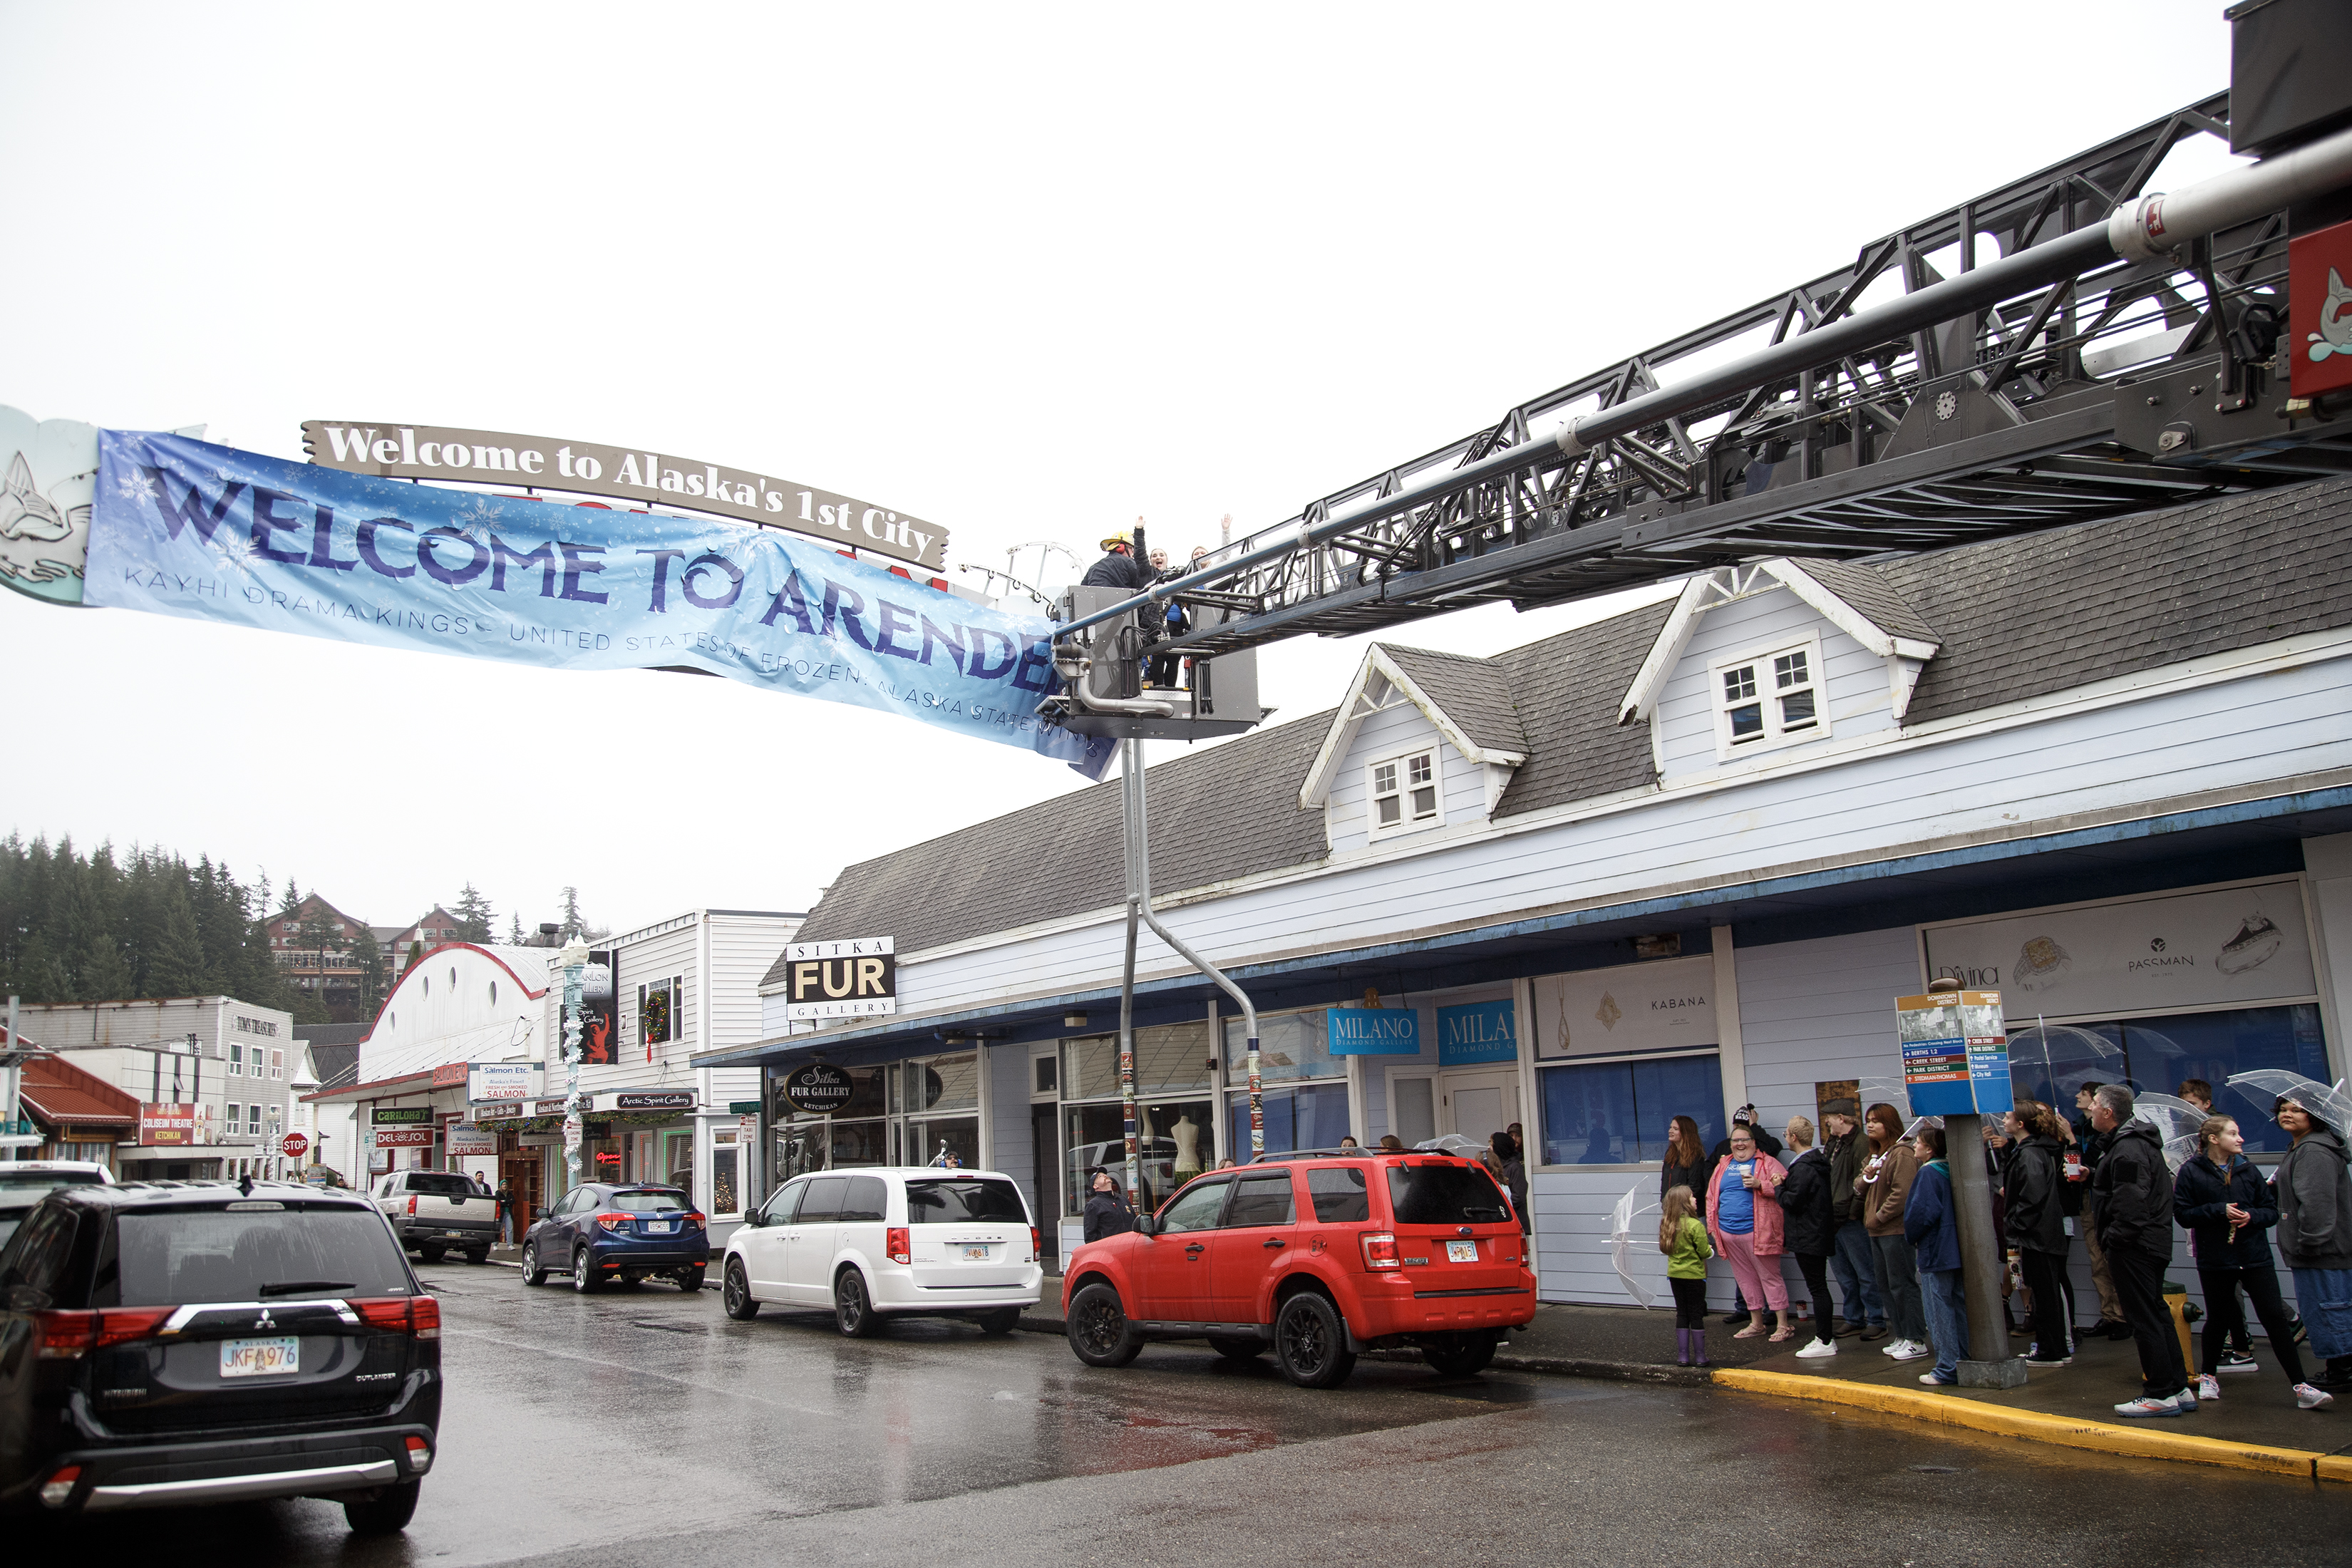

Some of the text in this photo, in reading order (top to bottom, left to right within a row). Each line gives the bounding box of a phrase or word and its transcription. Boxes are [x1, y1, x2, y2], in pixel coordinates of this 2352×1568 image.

[324, 428, 545, 474] Welcome
[556, 446, 602, 480] to
[614, 453, 783, 512] Alaska's
[797, 490, 852, 531] 1st
[862, 508, 935, 562] City
[136, 463, 609, 604] WELCOME
[636, 549, 745, 614] TO
[125, 567, 227, 598] KAYHI
[249, 587, 359, 621] DRAMA
[377, 609, 468, 634] KINGS
[510, 624, 610, 651] UNITED
[626, 631, 719, 652] STATES
[725, 642, 751, 661] OF
[878, 681, 962, 716] ALASKA
[972, 705, 1029, 731] STATE
[798, 941, 883, 957] SITKA
[2128, 955, 2194, 972] PASSMAN
[795, 958, 886, 999] FUR
[1651, 996, 1706, 1010] KABANA
[1927, 993, 1957, 1001] DOWNTOWN
[798, 1003, 888, 1016] GALLERY
[584, 1016, 604, 1024] Gallery
[1335, 1018, 1413, 1039] MILANO
[1448, 1011, 1515, 1045] MILA
[801, 1066, 840, 1085] Sitka
[791, 1087, 850, 1096] FUR GALLERY
[621, 1095, 688, 1106] Arctic Spirit Gallery
[143, 1118, 193, 1128] COLISEUM THEATRE
[155, 1131, 181, 1140] KETCHIKAN
[378, 1134, 396, 1143] DEL
[408, 1133, 426, 1142] SOL
[284, 1140, 306, 1150] STOP
[596, 1152, 621, 1164] Open
[421, 1207, 492, 1217] CHEVROLET
[225, 1346, 296, 1367] JKF 976
[356, 1373, 396, 1382] OUTLANDER
